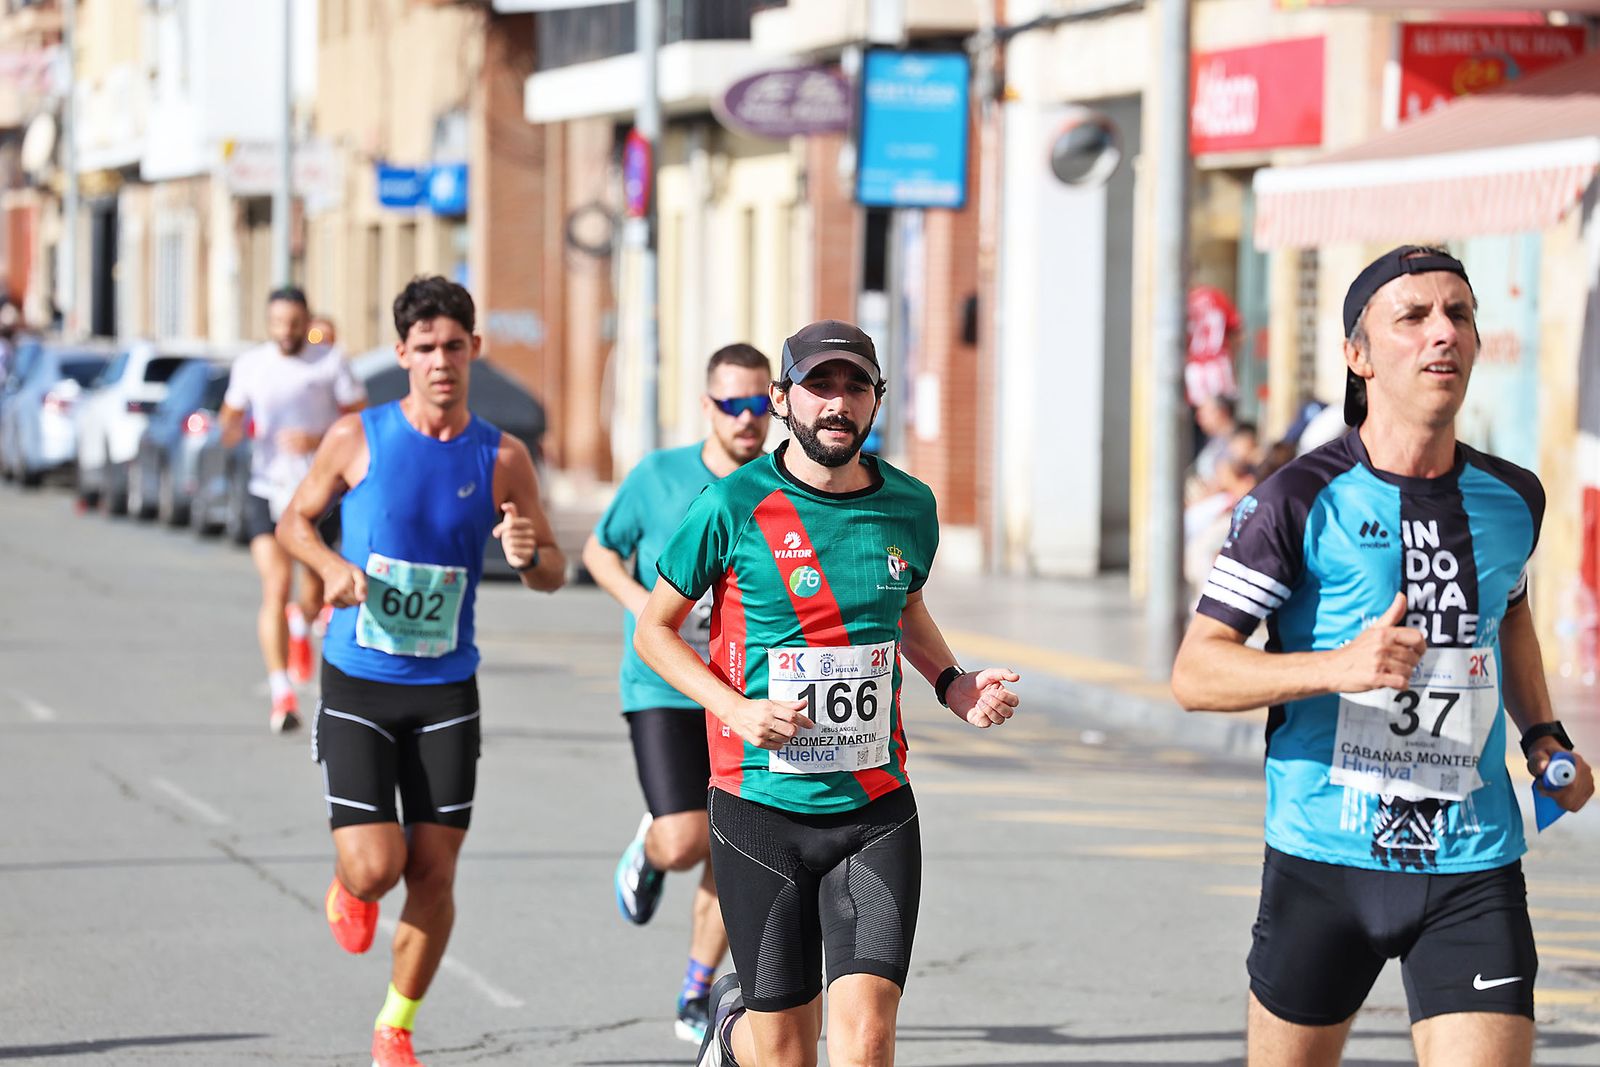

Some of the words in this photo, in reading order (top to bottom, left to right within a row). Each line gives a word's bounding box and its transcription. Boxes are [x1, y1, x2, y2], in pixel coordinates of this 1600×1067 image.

[1401, 520, 1440, 548] IN
[774, 549, 812, 559] VIATOR
[1406, 549, 1459, 581] DO
[382, 587, 444, 621] 602
[1407, 582, 1467, 612] MA
[1405, 613, 1479, 644] BLE
[797, 680, 878, 724] 166
[1389, 689, 1460, 738] 37
[790, 736, 835, 746] GOMEZ
[837, 732, 877, 745] MARTIN
[1341, 742, 1412, 763] CABAÑAS
[777, 746, 834, 762] Huelva
[1342, 755, 1411, 780] Huelva
